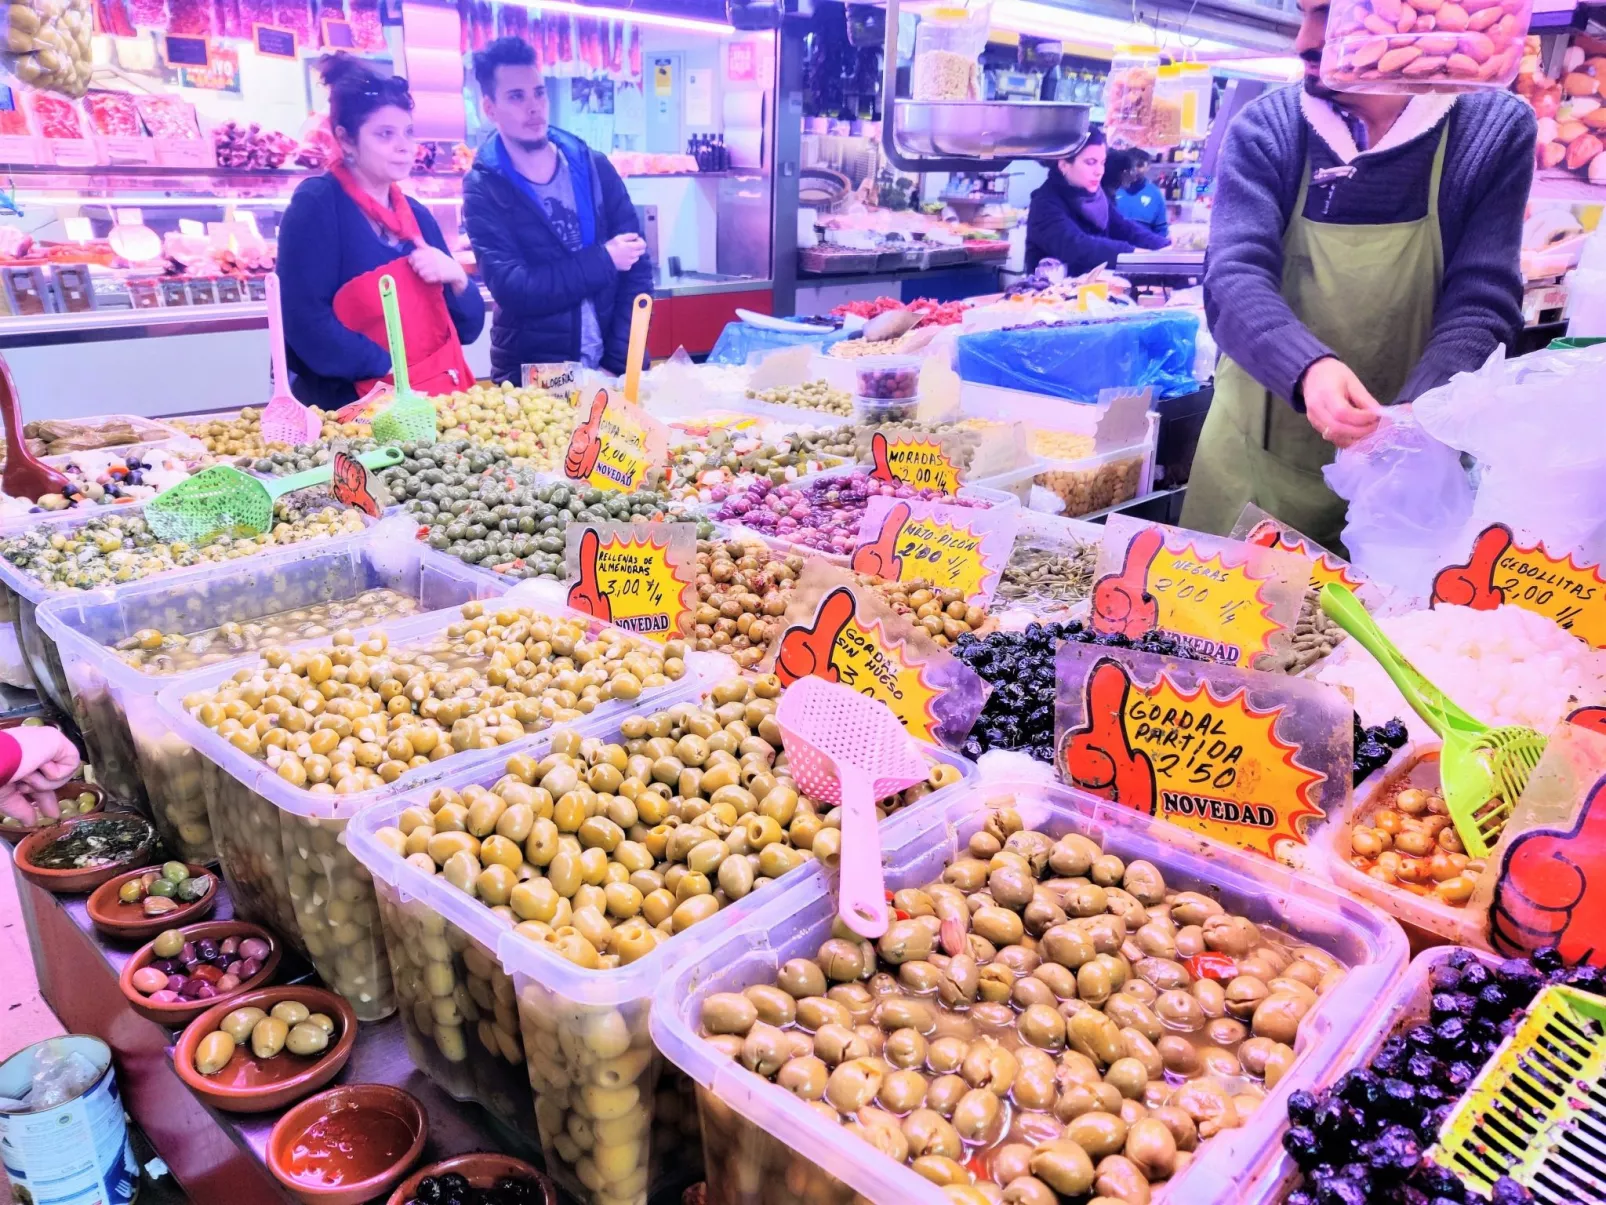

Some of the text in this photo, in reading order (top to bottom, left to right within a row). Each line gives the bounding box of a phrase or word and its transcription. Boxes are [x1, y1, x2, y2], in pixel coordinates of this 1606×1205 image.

[601, 442, 627, 463] 2,00
[889, 450, 943, 466] MORADAS
[596, 462, 632, 487] NOVEDAD
[901, 467, 947, 491] 2,00 1/4
[598, 550, 654, 565] RELLENAS DE
[598, 562, 651, 577] ALMENDRAS
[897, 542, 968, 580] 2'00 1/4
[1171, 560, 1230, 583] NEGRAS
[606, 578, 640, 598] 3,00
[1154, 578, 1245, 626] 2'00 1/4
[1501, 578, 1583, 630] 2,00 1/4
[845, 628, 899, 683] GORDAL
[1160, 631, 1240, 661] EDAD
[835, 637, 860, 658] SIN
[864, 660, 904, 701] HUESO
[1129, 700, 1227, 737] GORDAL
[1134, 722, 1243, 764] PARTIDA
[1156, 753, 1237, 790] 2'50
[1162, 792, 1275, 827] NOVEDAD
